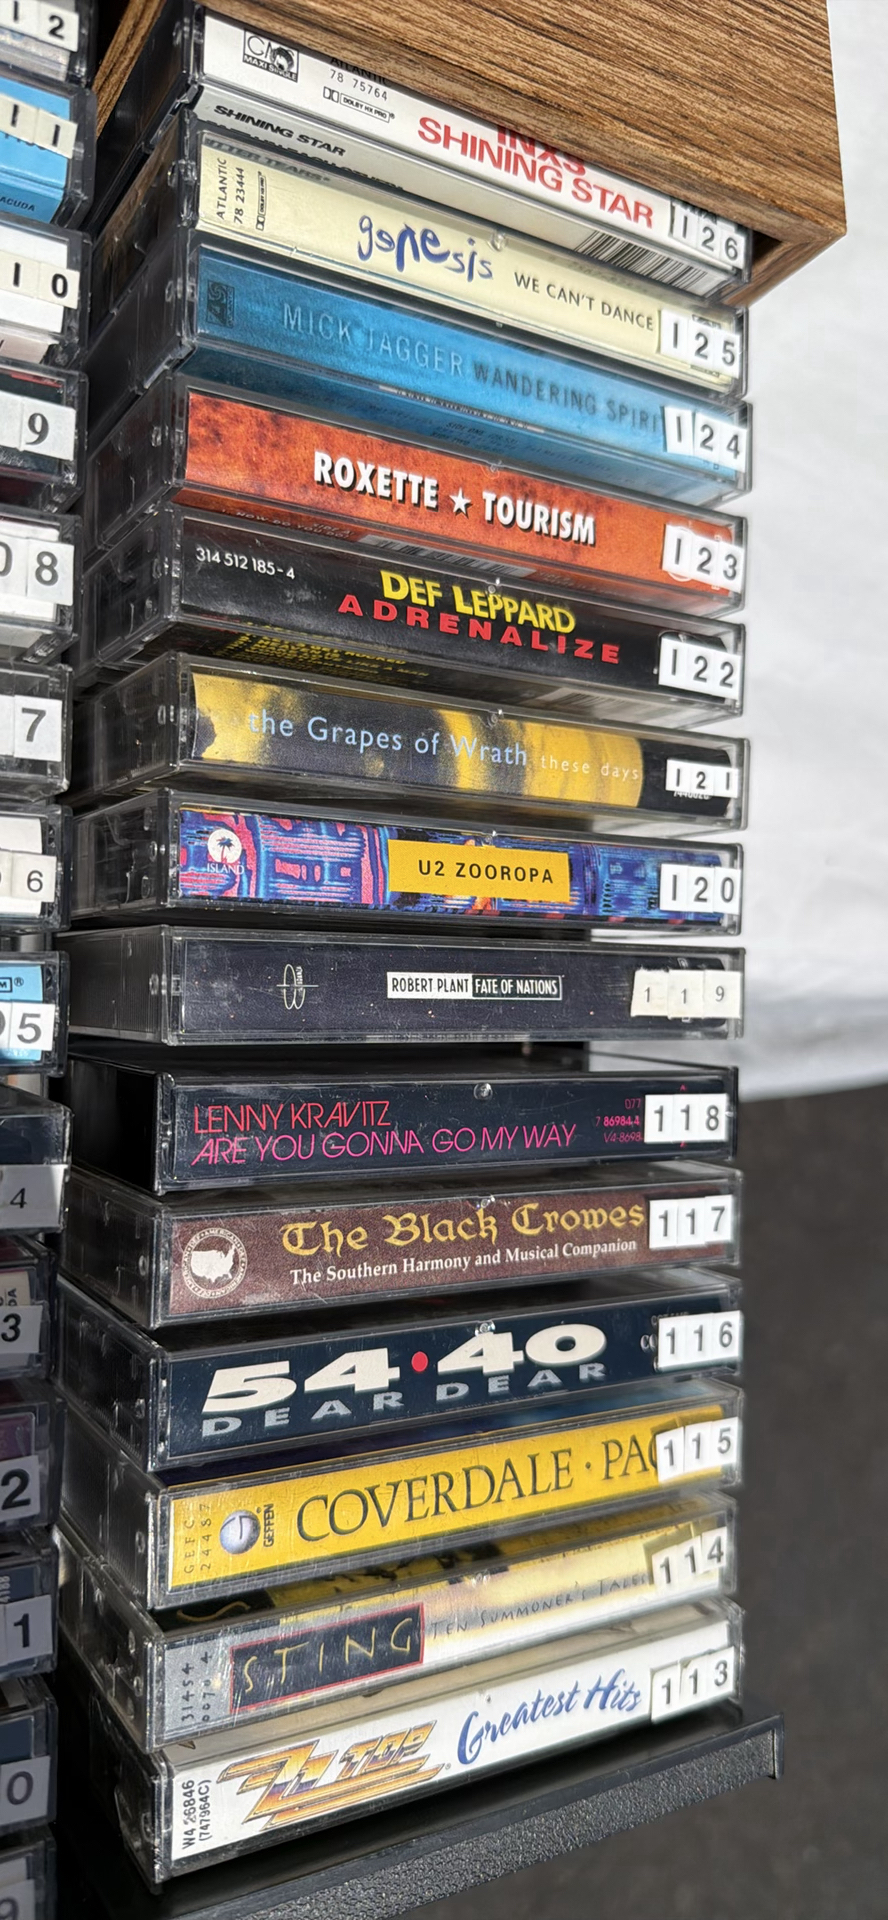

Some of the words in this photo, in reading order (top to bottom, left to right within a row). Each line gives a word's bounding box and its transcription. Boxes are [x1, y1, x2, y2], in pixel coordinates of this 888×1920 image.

[244, 55, 264, 68] MAXI
[330, 68, 344, 83] 78
[353, 78, 388, 101] 75764
[343, 97, 363, 112] DOLBY
[364, 104, 374, 115] HX
[374, 108, 387, 120] PRO
[214, 105, 293, 138] SHINING
[297, 134, 346, 157] STAR
[216, 158, 227, 220] ATLANTIC
[235, 167, 246, 204] 23444
[418, 117, 563, 193] SHINING
[572, 177, 654, 228] STAR
[234, 208, 244, 224] 78
[358, 215, 493, 282] genesis
[514, 272, 540, 293] WE
[546, 283, 595, 312] CAN'T
[601, 301, 654, 332] DANCE
[283, 303, 352, 341] MICK
[366, 325, 463, 377] JAGGER
[672, 322, 735, 367] 125
[473, 361, 597, 416] WANDERING
[606, 400, 662, 434] SPIRI
[676, 416, 740, 460] 124
[314, 451, 438, 509] ROXETTE
[482, 490, 596, 546] TOURISM
[196, 547, 221, 563] 314
[224, 551, 248, 570] 512
[675, 538, 737, 580] 123
[380, 570, 443, 607] DEF
[452, 585, 575, 634] LEPPARD
[338, 594, 620, 664] ADRENALIZE
[671, 648, 735, 688] 122
[248, 709, 294, 737] the
[307, 716, 402, 754] Grapes
[414, 732, 440, 755] of
[450, 734, 527, 766] Wrath
[540, 756, 590, 774] these
[600, 762, 639, 781] days
[675, 768, 732, 790] 121
[206, 862, 245, 876] ISLAND
[418, 859, 445, 876] U2
[455, 861, 553, 884] ZOOROPA
[671, 874, 734, 903] 120
[392, 977, 433, 993] ROBERT
[437, 978, 469, 993] PLANT
[475, 978, 498, 994] FATE
[501, 978, 513, 994] OF
[516, 978, 558, 996] NATIONS
[644, 985, 725, 1004] 119
[194, 1104, 284, 1134] LENNY
[291, 1100, 391, 1129] KRAVITZ
[604, 1132, 643, 1143] V4-8698
[654, 1104, 720, 1132] 118
[191, 1137, 248, 1166] ARE
[255, 1134, 315, 1161] YOU
[322, 1130, 424, 1158] GONNA
[432, 1127, 475, 1153] GO
[480, 1126, 518, 1150] MY
[522, 1124, 576, 1148] WAY
[280, 1221, 368, 1257] The
[382, 1207, 498, 1247] Black
[512, 1203, 645, 1236] Crowes
[659, 1206, 725, 1237] 117
[290, 1268, 321, 1285] The
[327, 1262, 397, 1282] Southern
[403, 1255, 471, 1274] Harmony
[475, 1252, 501, 1266] and
[505, 1242, 558, 1264] Musical
[562, 1238, 637, 1259] Companion
[666, 1321, 733, 1354] 116
[202, 1391, 404, 1437] DEAR
[436, 1363, 606, 1401] DEAR
[664, 1428, 731, 1466] 115
[297, 1448, 574, 1542] COVERDALE
[602, 1434, 659, 1481] PA
[263, 1503, 274, 1547] GEFFEN
[660, 1536, 724, 1584] 114
[430, 1620, 468, 1639] TEN
[480, 1581, 586, 1628] SUMMONER'S
[598, 1574, 647, 1595] TALES
[244, 1618, 413, 1693] STING
[662, 1660, 728, 1704] 113
[457, 1680, 581, 1764] Greatest
[584, 1669, 641, 1712] Hits
[181, 1780, 196, 1825] 26846
[197, 1779, 213, 1841] (747964C)
[182, 1828, 196, 1850] W4
